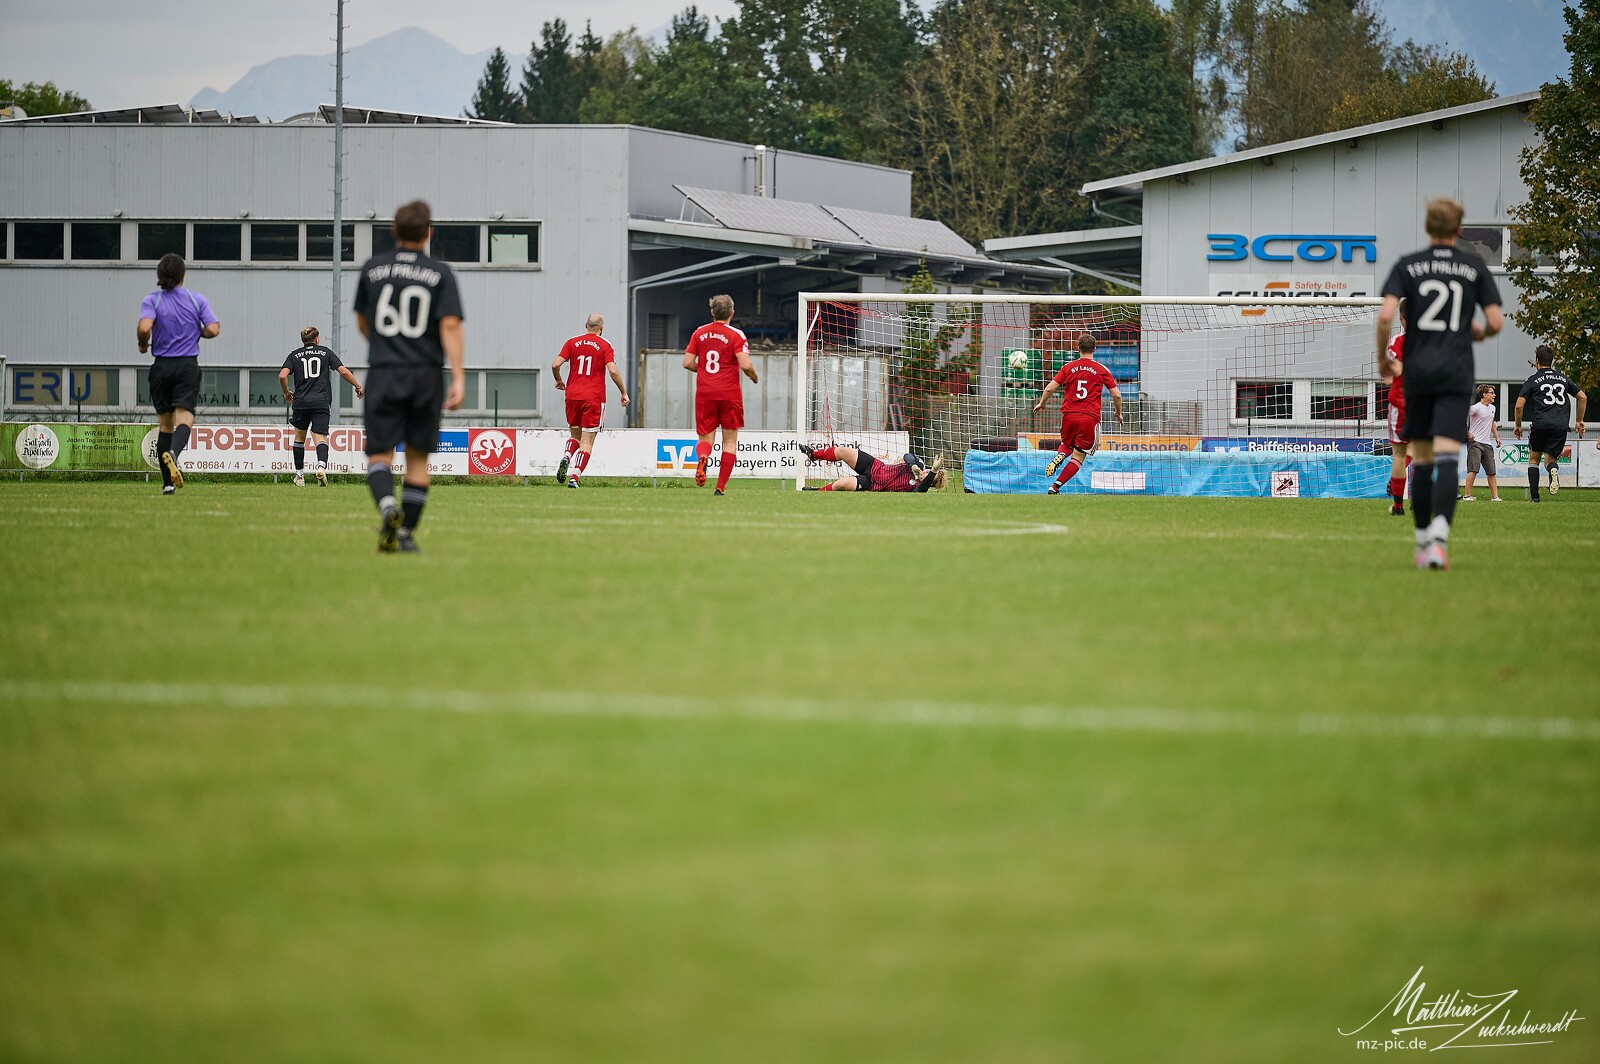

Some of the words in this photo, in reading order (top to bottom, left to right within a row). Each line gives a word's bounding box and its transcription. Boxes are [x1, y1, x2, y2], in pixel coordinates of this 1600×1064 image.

[1295, 281, 1322, 292] Safety
[1325, 281, 1347, 290] Belts
[375, 283, 431, 338] 60
[1417, 279, 1463, 332] 21
[699, 332, 708, 341] SV
[709, 332, 729, 344] Laufen
[575, 340, 582, 348] SV
[583, 339, 600, 351] Laufen
[301, 356, 321, 379] 10
[577, 354, 592, 376] 11
[705, 350, 720, 374] 8
[1071, 366, 1079, 374] SV
[1079, 365, 1097, 376] Laufen
[1534, 375, 1545, 384] TSV
[1076, 379, 1088, 400] 5
[1540, 383, 1565, 405] 33
[480, 439, 508, 460] SV
[713, 440, 772, 452] olbank
[1106, 440, 1188, 452] Transporte
[1248, 441, 1340, 452] Raiffeisenbank
[197, 461, 225, 470] 08684
[234, 461, 240, 470] 4
[244, 461, 254, 470] 71
[271, 462, 293, 470] 8341
[441, 463, 453, 472] 22
[706, 456, 777, 470] Obbayern
